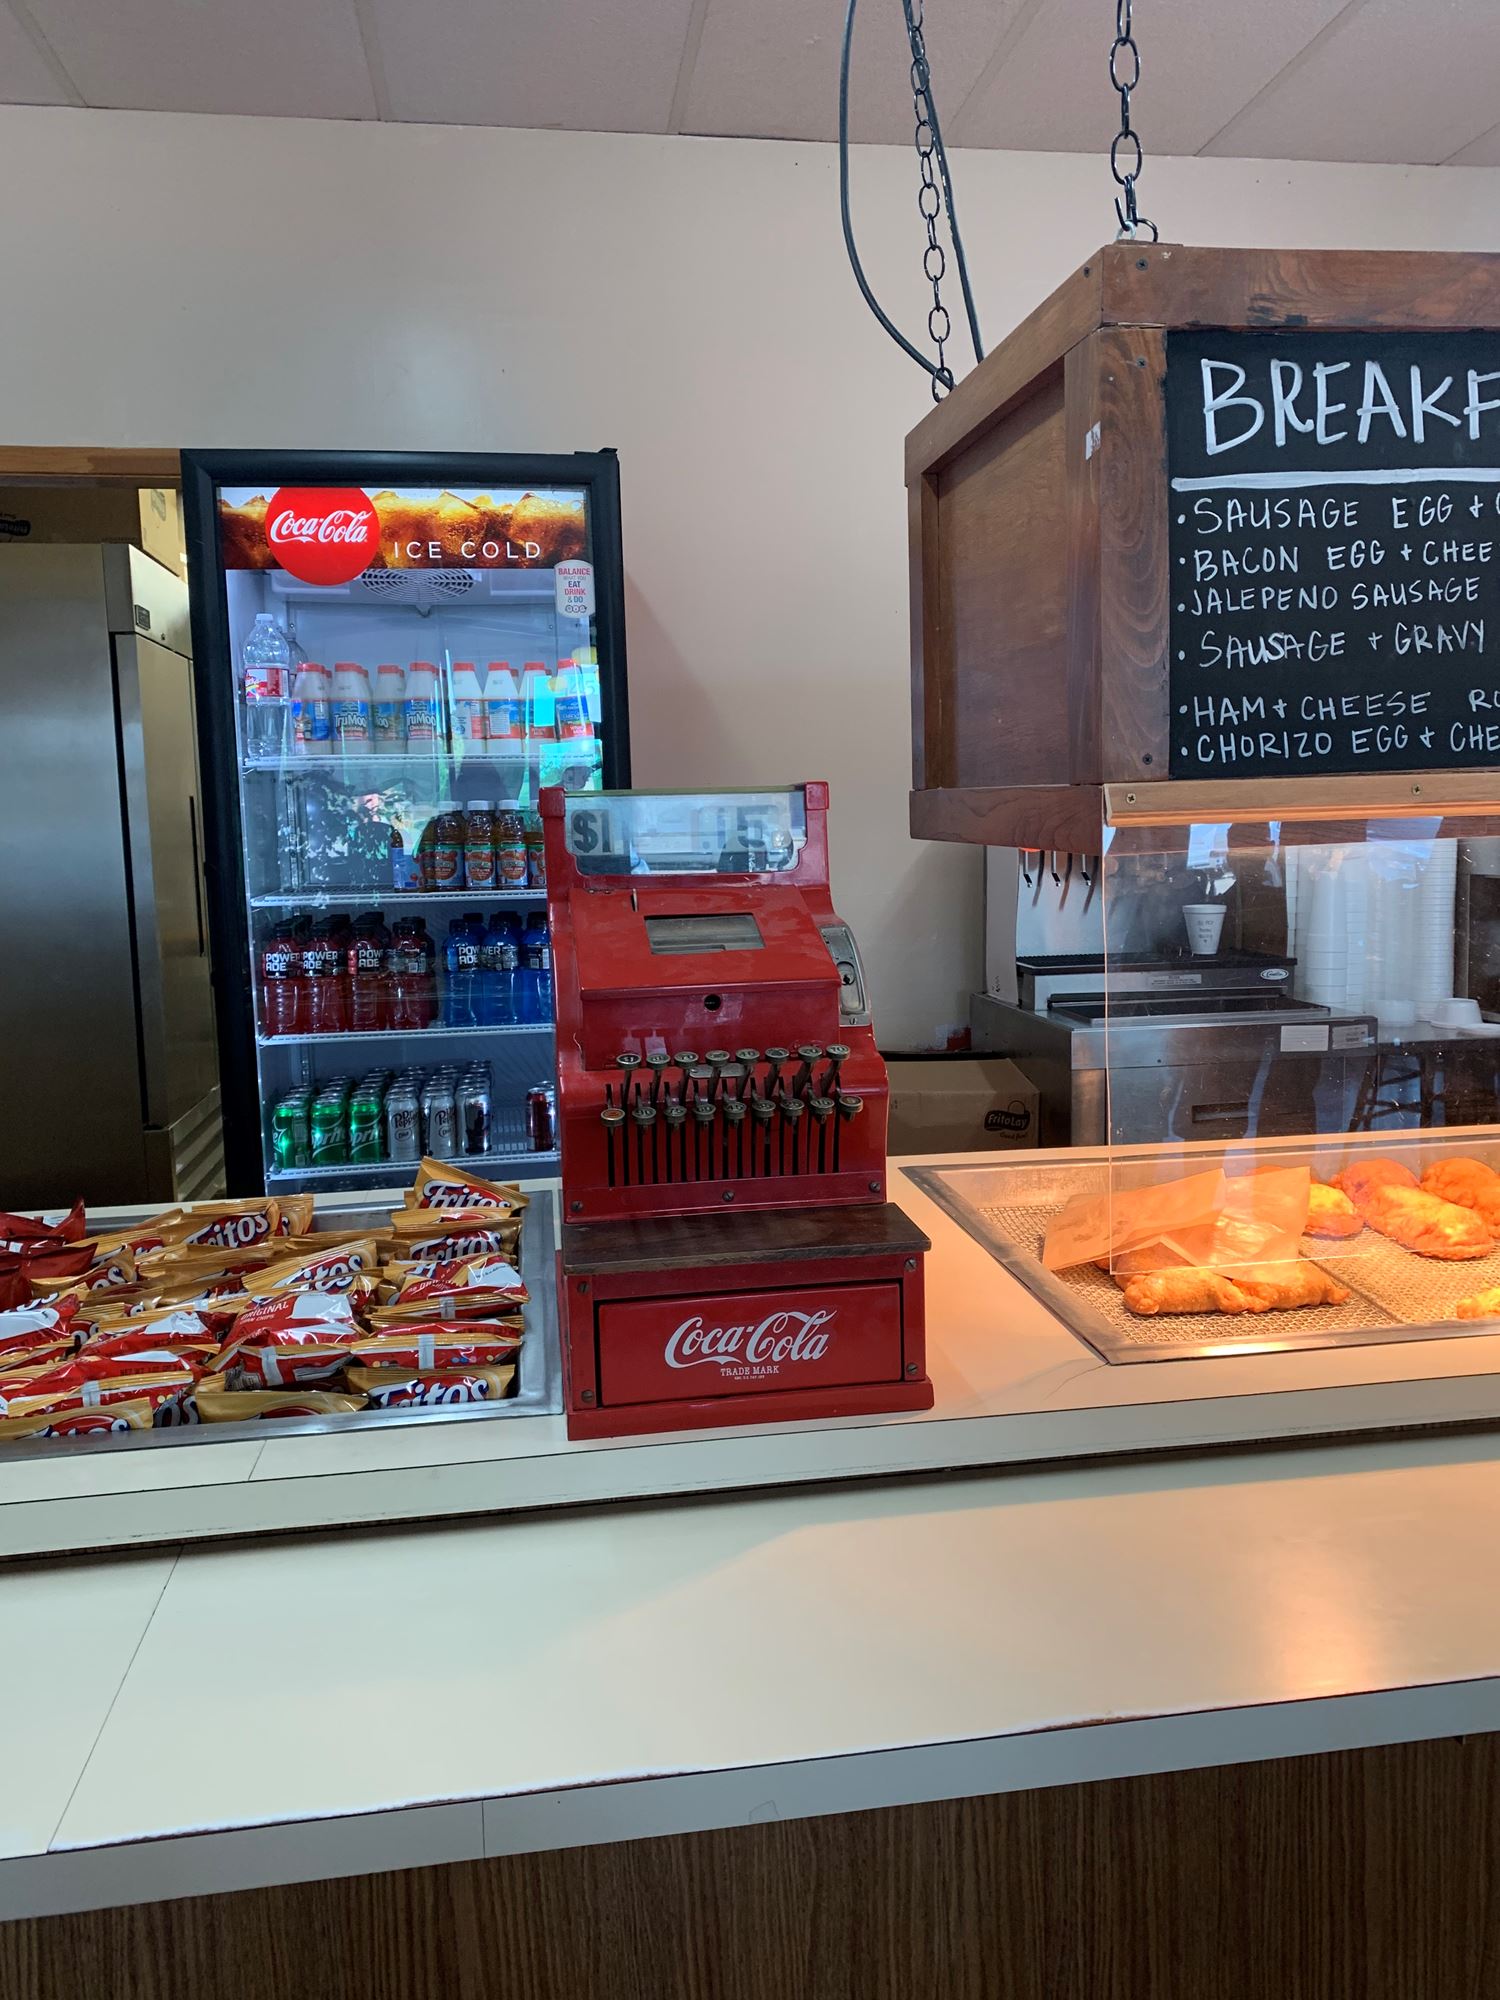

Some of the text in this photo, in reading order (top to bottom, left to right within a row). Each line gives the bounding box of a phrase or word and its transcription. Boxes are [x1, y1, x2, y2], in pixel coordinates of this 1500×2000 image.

[1200, 358, 1500, 456] BREAKF
[270, 509, 373, 544] Coca-Cola
[1193, 497, 1360, 534] SAUSAGE
[1392, 493, 1454, 529] EGG
[394, 541, 541, 559] ICE COLD
[1193, 545, 1299, 583] BACON
[1327, 540, 1386, 571] EGG
[1422, 539, 1493, 566] CHEE
[558, 567, 591, 576] BALANCE
[568, 580, 581, 588] EAT
[564, 588, 587, 596] DRINK
[1191, 576, 1480, 616] JALEPENO SAUSAGE
[1199, 630, 1346, 669] SAUSAGE
[1394, 618, 1485, 655] GRAVY
[1193, 695, 1266, 727] HAM
[1301, 690, 1432, 721] CHEESE
[1197, 731, 1332, 764] CHORIZO
[1351, 724, 1409, 755] EGG
[265, 962, 287, 971] ADE
[302, 951, 338, 961] POWER
[303, 961, 322, 969] ADE
[358, 959, 380, 968] ADE
[272, 1254, 363, 1294] itos
[664, 1309, 838, 1369] Coca-Cola
[720, 1365, 780, 1377] TRADE MARK
